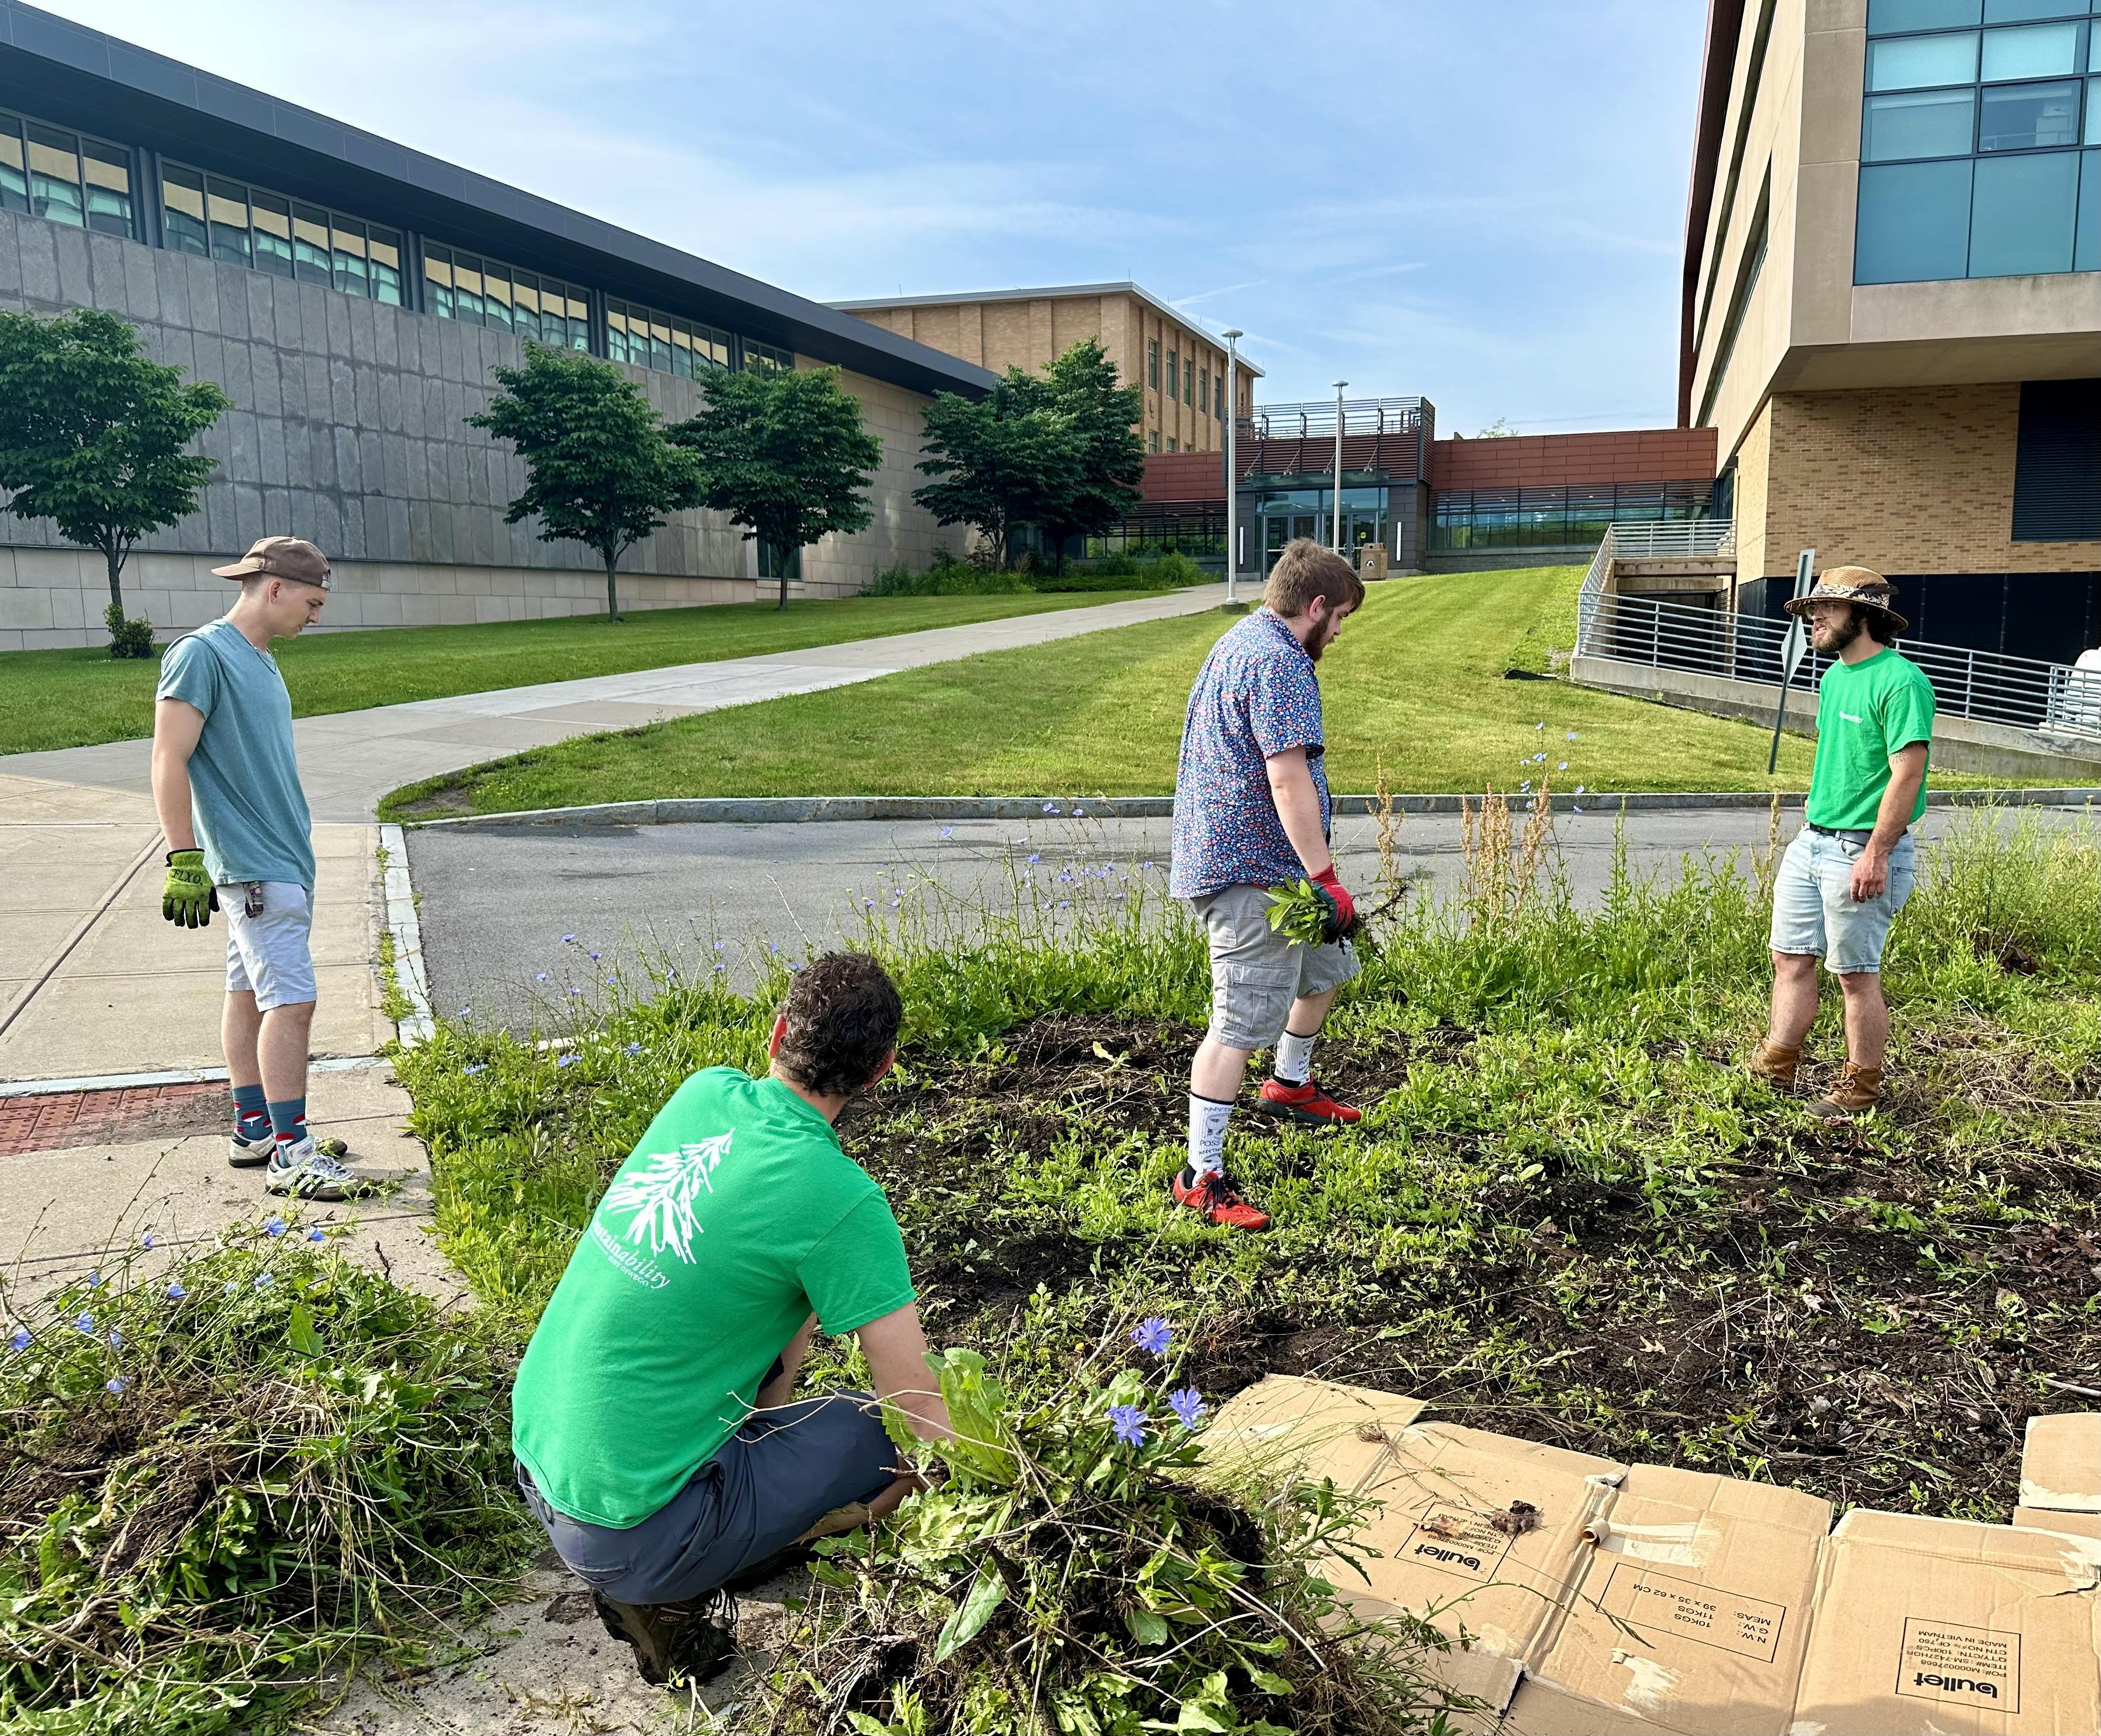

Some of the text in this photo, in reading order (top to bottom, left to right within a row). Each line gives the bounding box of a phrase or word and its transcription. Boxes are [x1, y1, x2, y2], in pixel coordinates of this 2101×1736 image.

[1414, 1544, 1481, 1571] bullet
[1633, 1583, 1651, 1593] CM
[1653, 1589, 1666, 1597] 62
[1678, 1596, 1692, 1604] 35
[1678, 1606, 1714, 1620] 11KGS
[1674, 1614, 1711, 1628] 10KGS
[1733, 1611, 1771, 1626] MEAS:
[1918, 1631, 1962, 1641] VIETNAM
[1978, 1639, 2006, 1648] MADE
[1915, 1645, 1952, 1654] 100PCS
[1986, 1647, 2006, 1656] CTN
[1913, 1673, 1997, 1699] bullet
